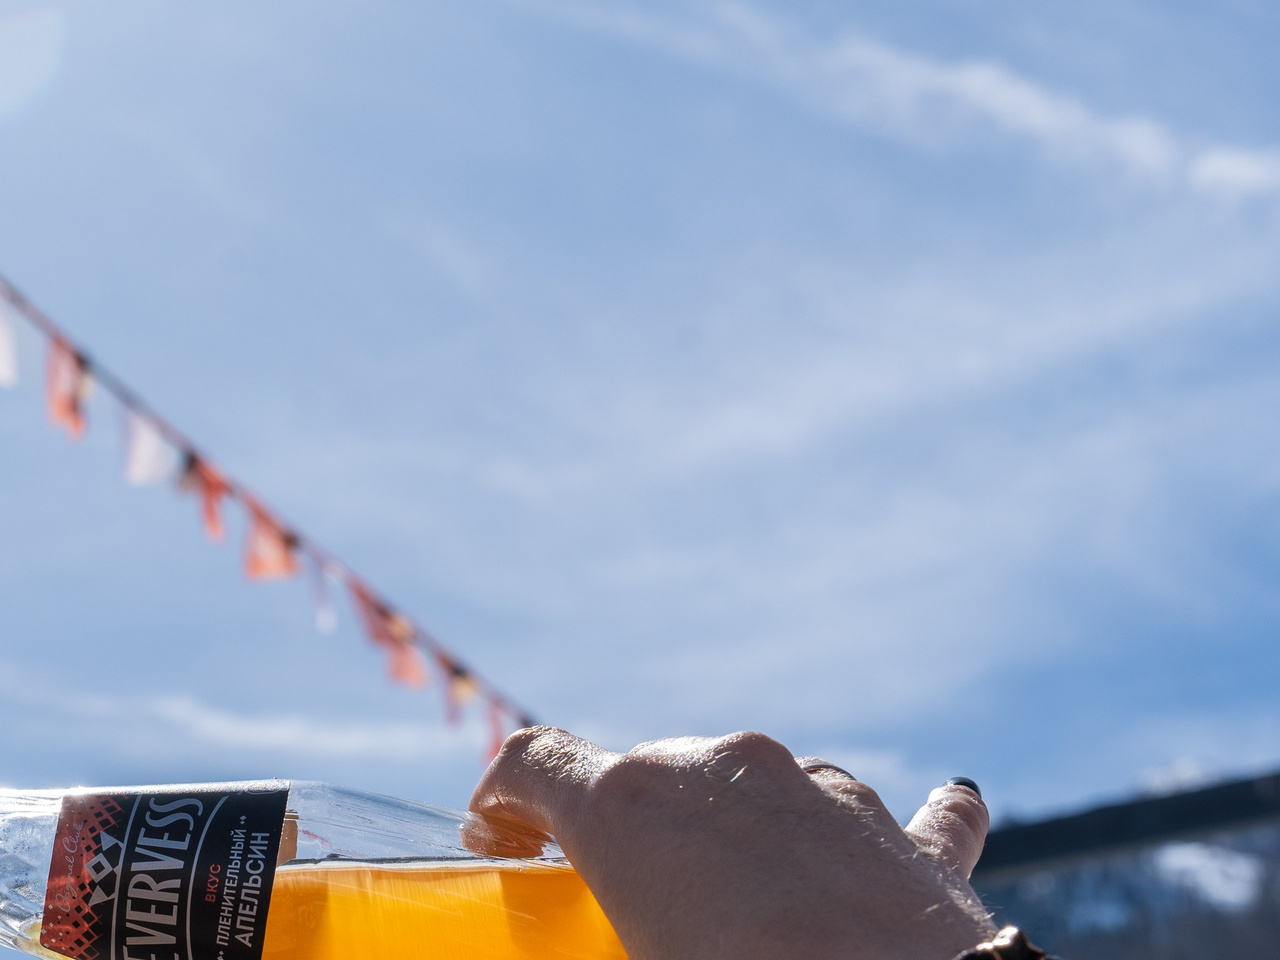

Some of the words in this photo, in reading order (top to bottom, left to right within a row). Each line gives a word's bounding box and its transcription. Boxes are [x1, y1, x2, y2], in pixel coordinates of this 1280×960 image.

[63, 821, 84, 853] Club
[205, 863, 221, 903] ВКУС
[216, 829, 247, 946] ПЛЕНИТЕЛЬНЫЙ
[234, 832, 270, 948] АПЕЛЬСИН
